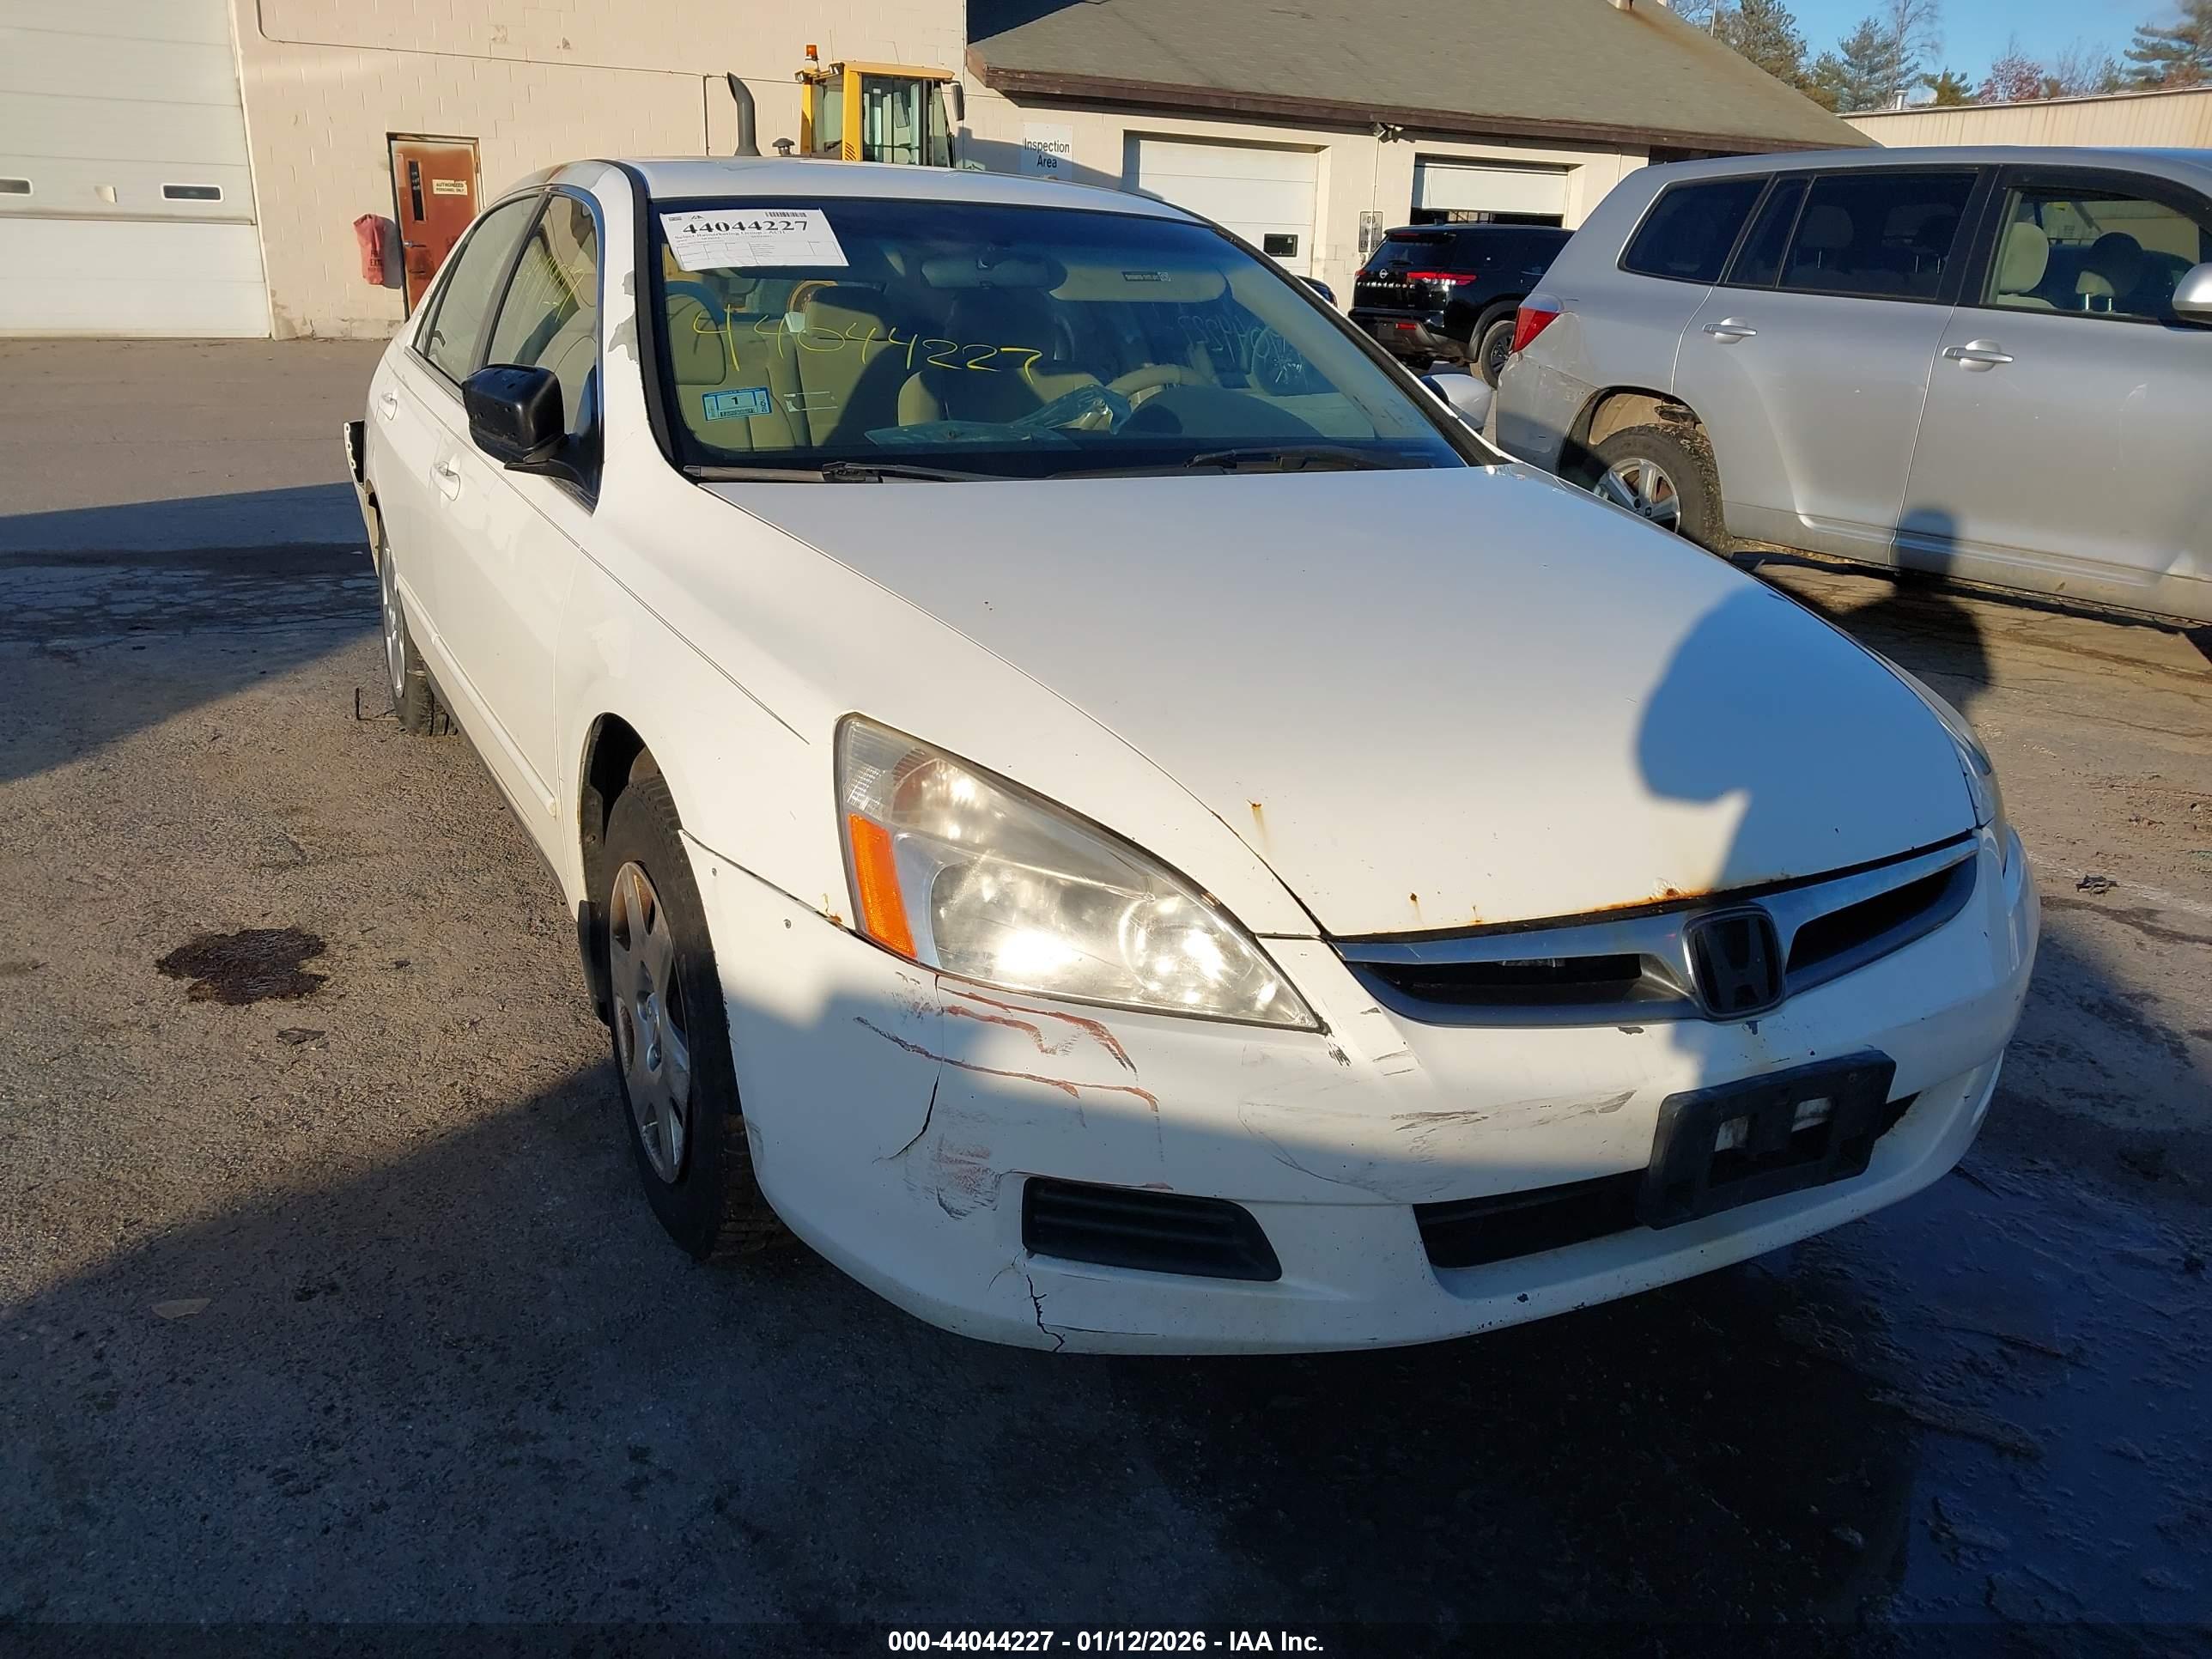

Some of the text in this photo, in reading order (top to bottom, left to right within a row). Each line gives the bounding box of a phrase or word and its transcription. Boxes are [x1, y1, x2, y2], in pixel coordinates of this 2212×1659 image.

[1024, 137, 1070, 154] Inspection
[1037, 155, 1057, 168] Area
[682, 220, 808, 234] 44044227
[692, 303, 1042, 385] 44044227
[731, 397, 738, 405] 1
